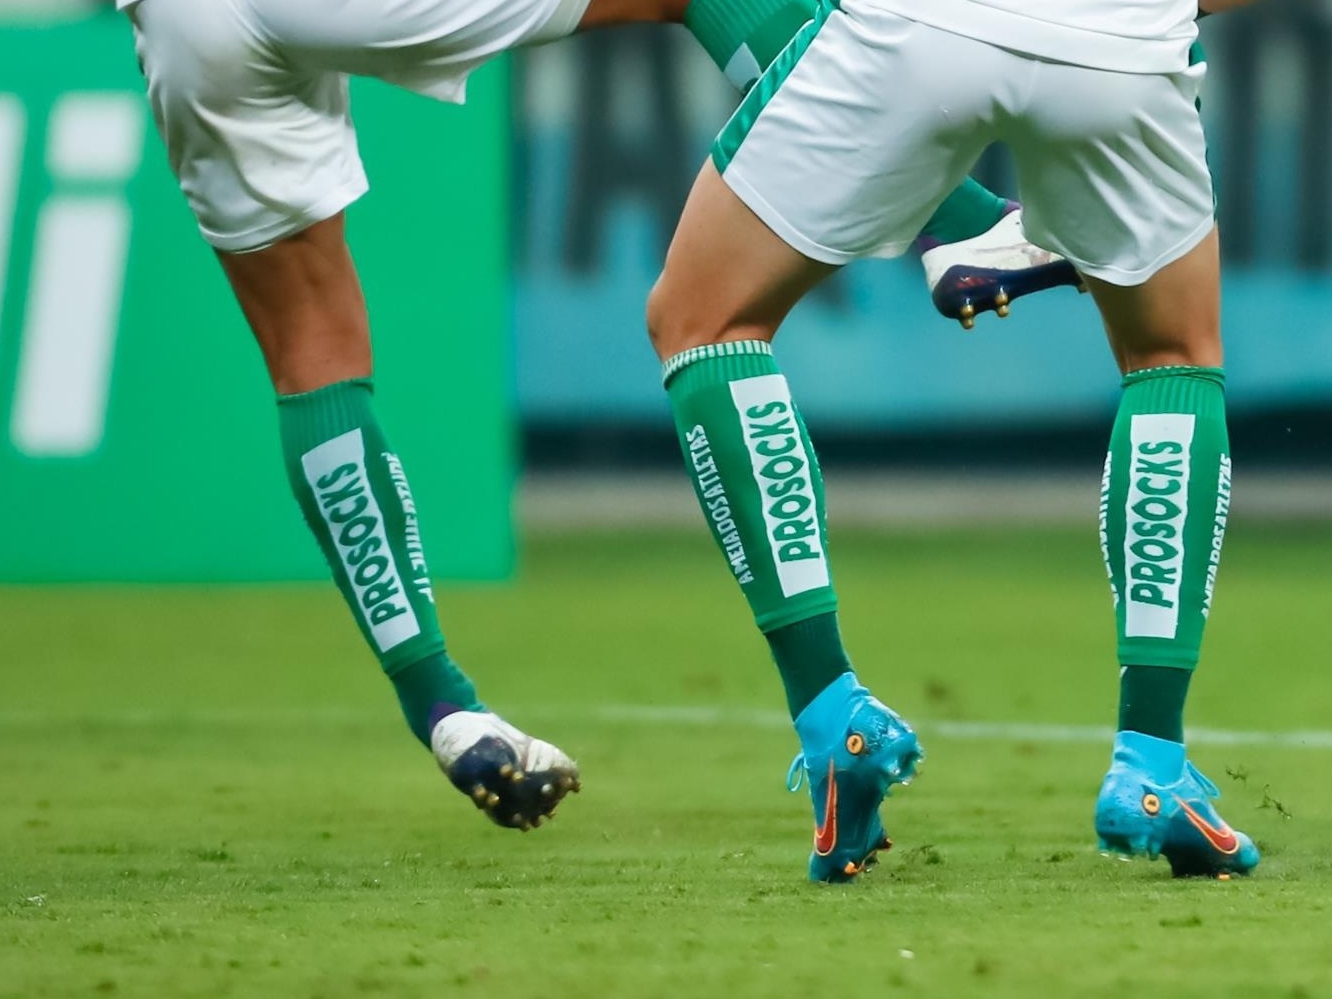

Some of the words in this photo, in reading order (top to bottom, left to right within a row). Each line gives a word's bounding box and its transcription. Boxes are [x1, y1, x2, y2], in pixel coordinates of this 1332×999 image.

[316, 461, 408, 627] PROSOCKS
[746, 400, 821, 563] PROSOCKS
[1129, 440, 1184, 609] PROSOCKS
